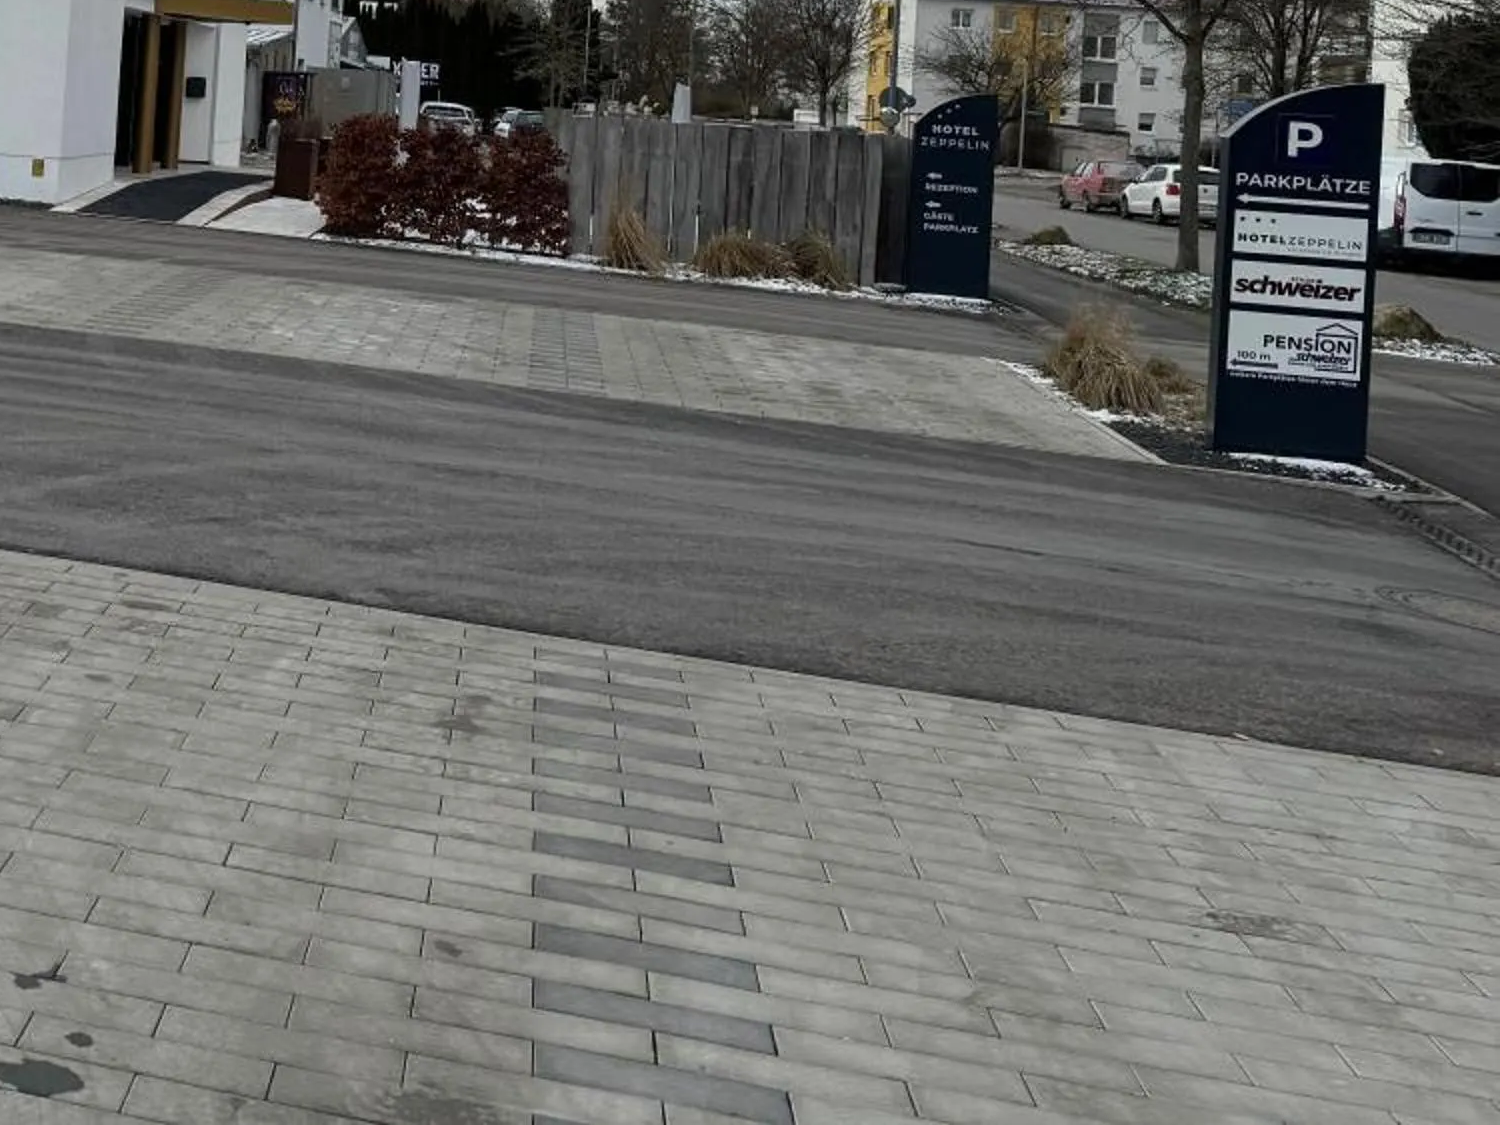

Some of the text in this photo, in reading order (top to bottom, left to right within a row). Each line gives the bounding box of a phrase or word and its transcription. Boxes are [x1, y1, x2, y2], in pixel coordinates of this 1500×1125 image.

[931, 124, 980, 136] HOTEL
[1287, 120, 1324, 158] P
[921, 136, 989, 151] ZEPPELIN
[1235, 172, 1372, 196] PARKPLÄTZE
[1234, 275, 1362, 302] schweizer
[1236, 350, 1257, 360] 100
[1263, 334, 1352, 355] PENSION
